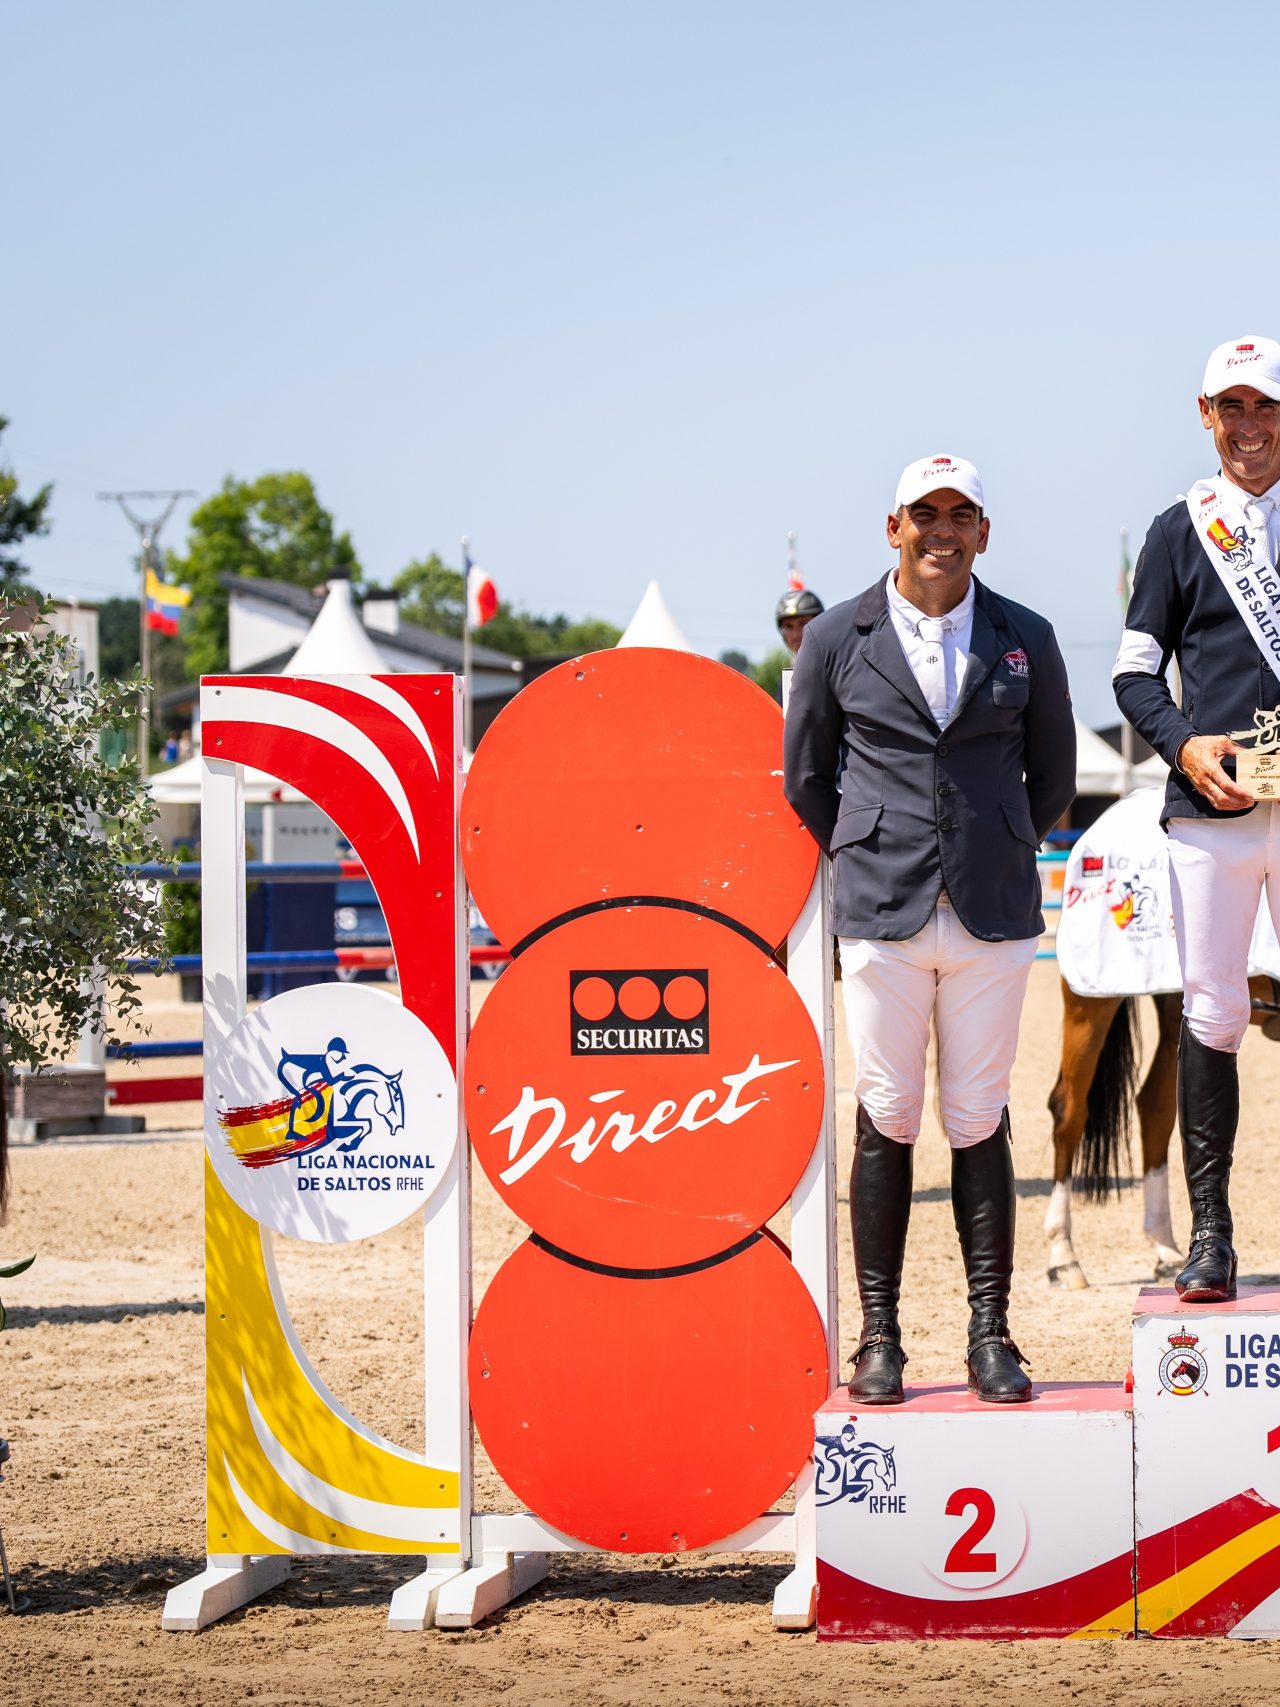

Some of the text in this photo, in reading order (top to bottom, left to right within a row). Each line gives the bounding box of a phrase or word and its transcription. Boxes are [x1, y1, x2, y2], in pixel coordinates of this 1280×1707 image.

[1235, 576, 1257, 601] DE
[576, 1028, 704, 1050] SECURITAS
[489, 1053, 801, 1186] Direct
[296, 1155, 435, 1169] LIGA NACIONAL
[296, 1177, 424, 1191] DE SALTOS RFHE
[1225, 1364, 1259, 1388] DE
[869, 1495, 907, 1514] RFHE
[943, 1487, 997, 1573] 2
